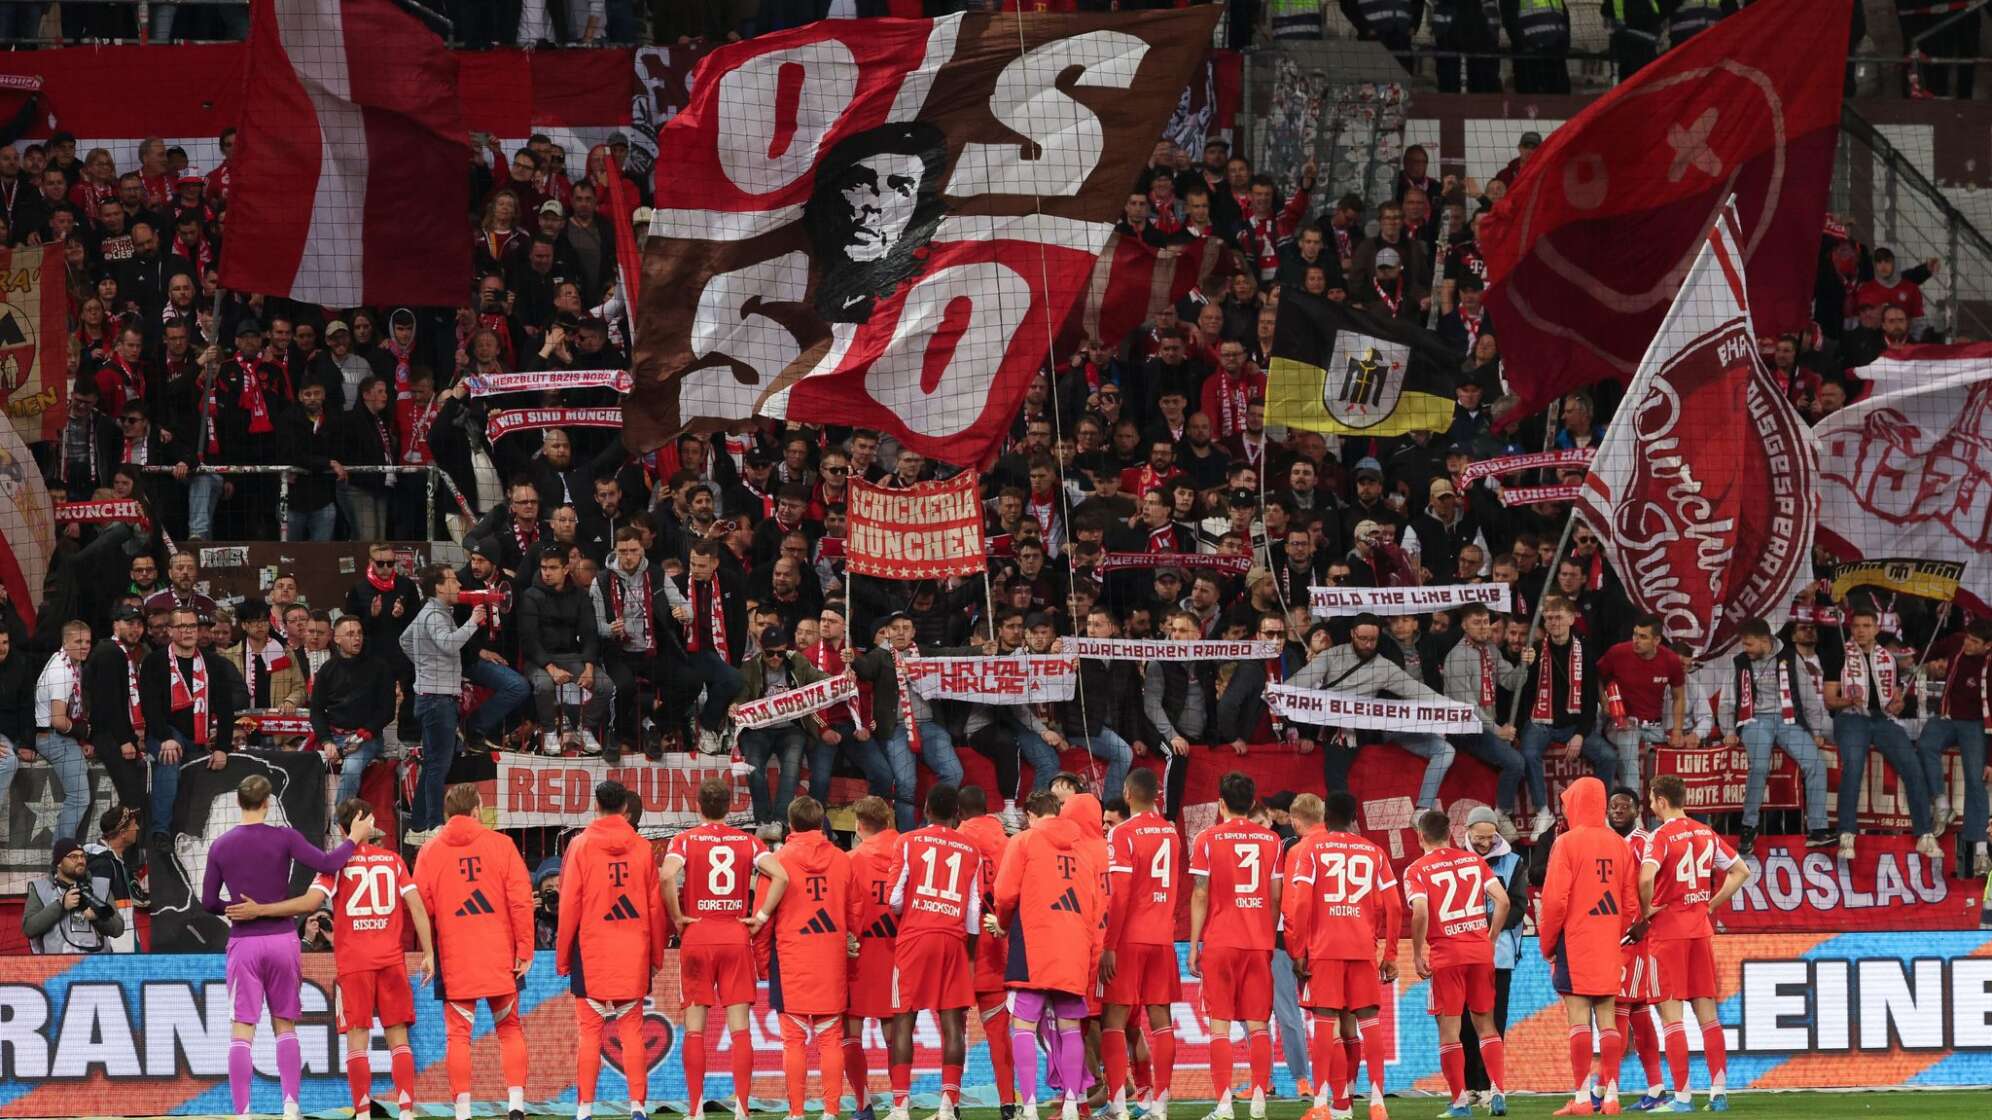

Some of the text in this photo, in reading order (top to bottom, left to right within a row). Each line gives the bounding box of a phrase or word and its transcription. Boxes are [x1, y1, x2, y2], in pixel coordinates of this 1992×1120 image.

[497, 409, 623, 428] WIR SIND MÜNCHE
[852, 485, 977, 525] SCHICKERIA
[850, 521, 982, 562] MÜNCHEN
[1315, 592, 1364, 607] HOLD
[906, 659, 1074, 681] SPUR HALTEN
[1193, 643, 1252, 657] RAMBO
[1416, 706, 1473, 722] MAGA
[1676, 753, 1710, 773] LOVE
[1713, 751, 1728, 770] FC
[507, 767, 591, 814] RED
[708, 845, 736, 896] 8
[916, 846, 962, 903] 11
[1151, 837, 1171, 888] 4
[1234, 844, 1260, 894] 3
[1320, 853, 1374, 904] 39
[1676, 838, 1714, 889] 44
[343, 865, 396, 917] 20
[697, 899, 743, 911] GORETZKA
[1430, 865, 1486, 923] 22
[353, 919, 389, 931] BISCHOF
